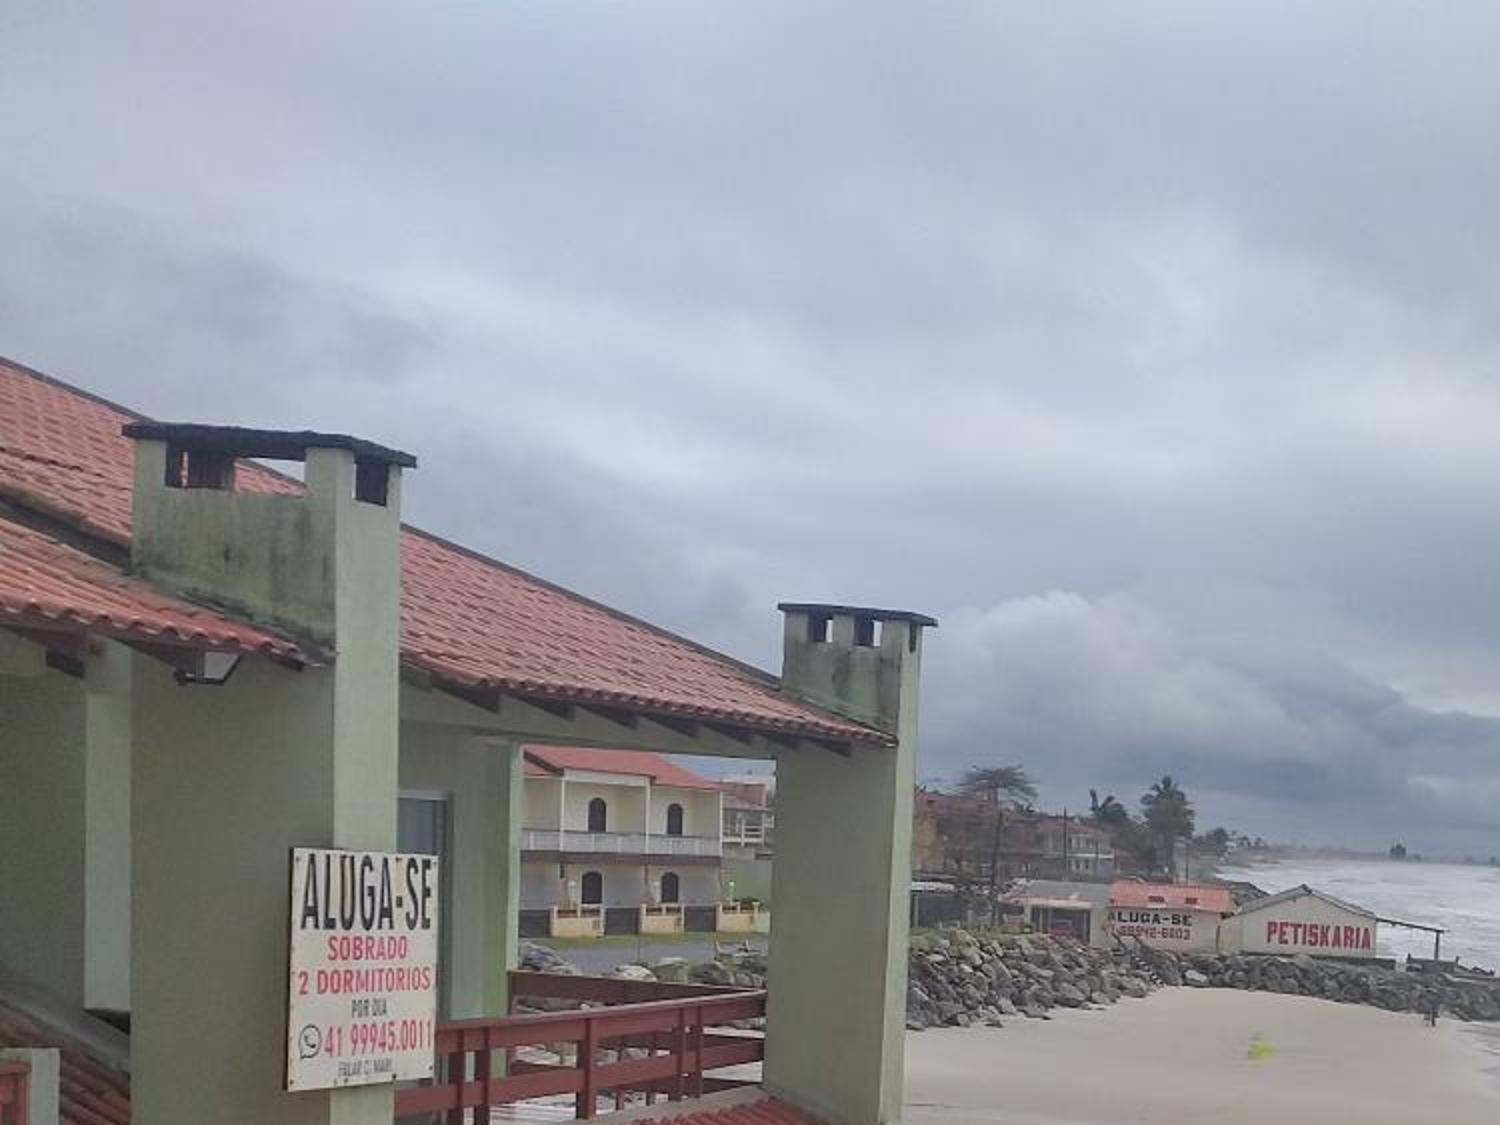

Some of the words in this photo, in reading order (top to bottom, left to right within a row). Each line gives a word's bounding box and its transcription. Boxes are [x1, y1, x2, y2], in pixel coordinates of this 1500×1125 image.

[300, 853, 432, 931] ALUGA-SE
[1107, 911, 1192, 926] ALUGA-SE
[328, 935, 408, 961] SOBRADO
[1266, 921, 1371, 949] PETISKARIA
[299, 971, 309, 995] 2
[317, 967, 431, 994] DORMITORIOS
[324, 1026, 342, 1057] 41
[351, 1020, 432, 1056] 99945.0011
